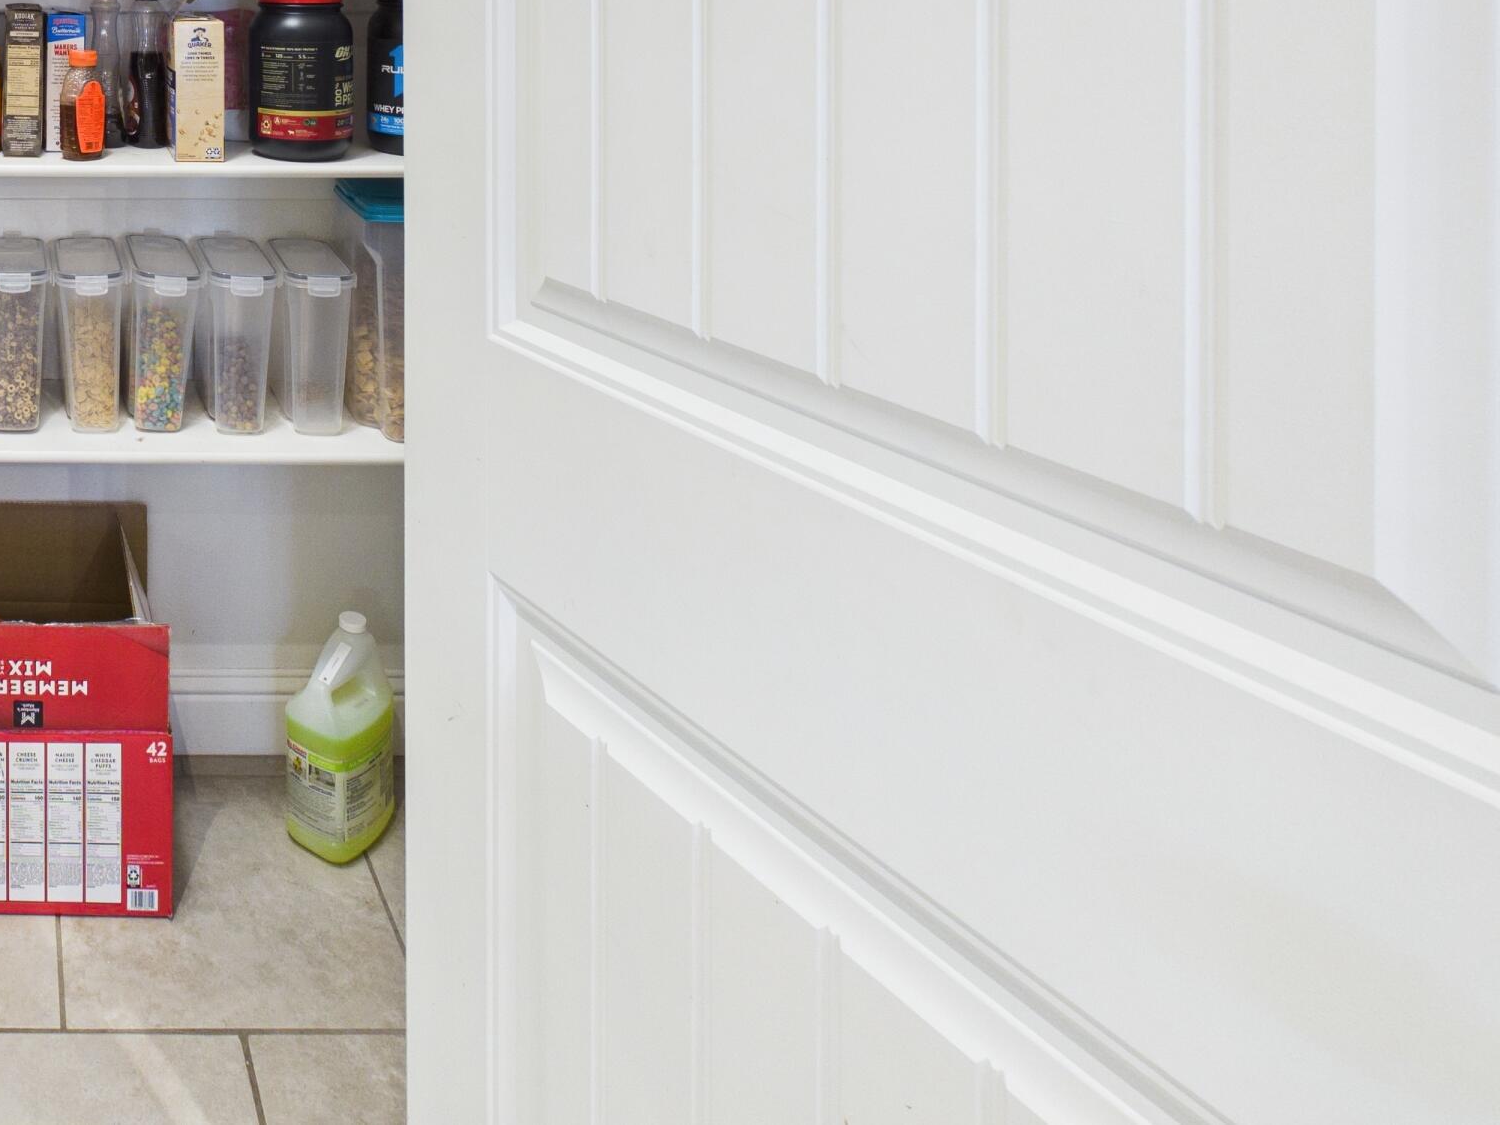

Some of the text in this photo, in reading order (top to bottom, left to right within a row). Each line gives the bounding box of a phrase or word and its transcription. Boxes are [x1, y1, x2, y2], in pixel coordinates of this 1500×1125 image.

[381, 65, 404, 74] RUL
[373, 103, 395, 113] WHEY
[8, 660, 52, 676] MIX
[146, 742, 168, 757] 42
